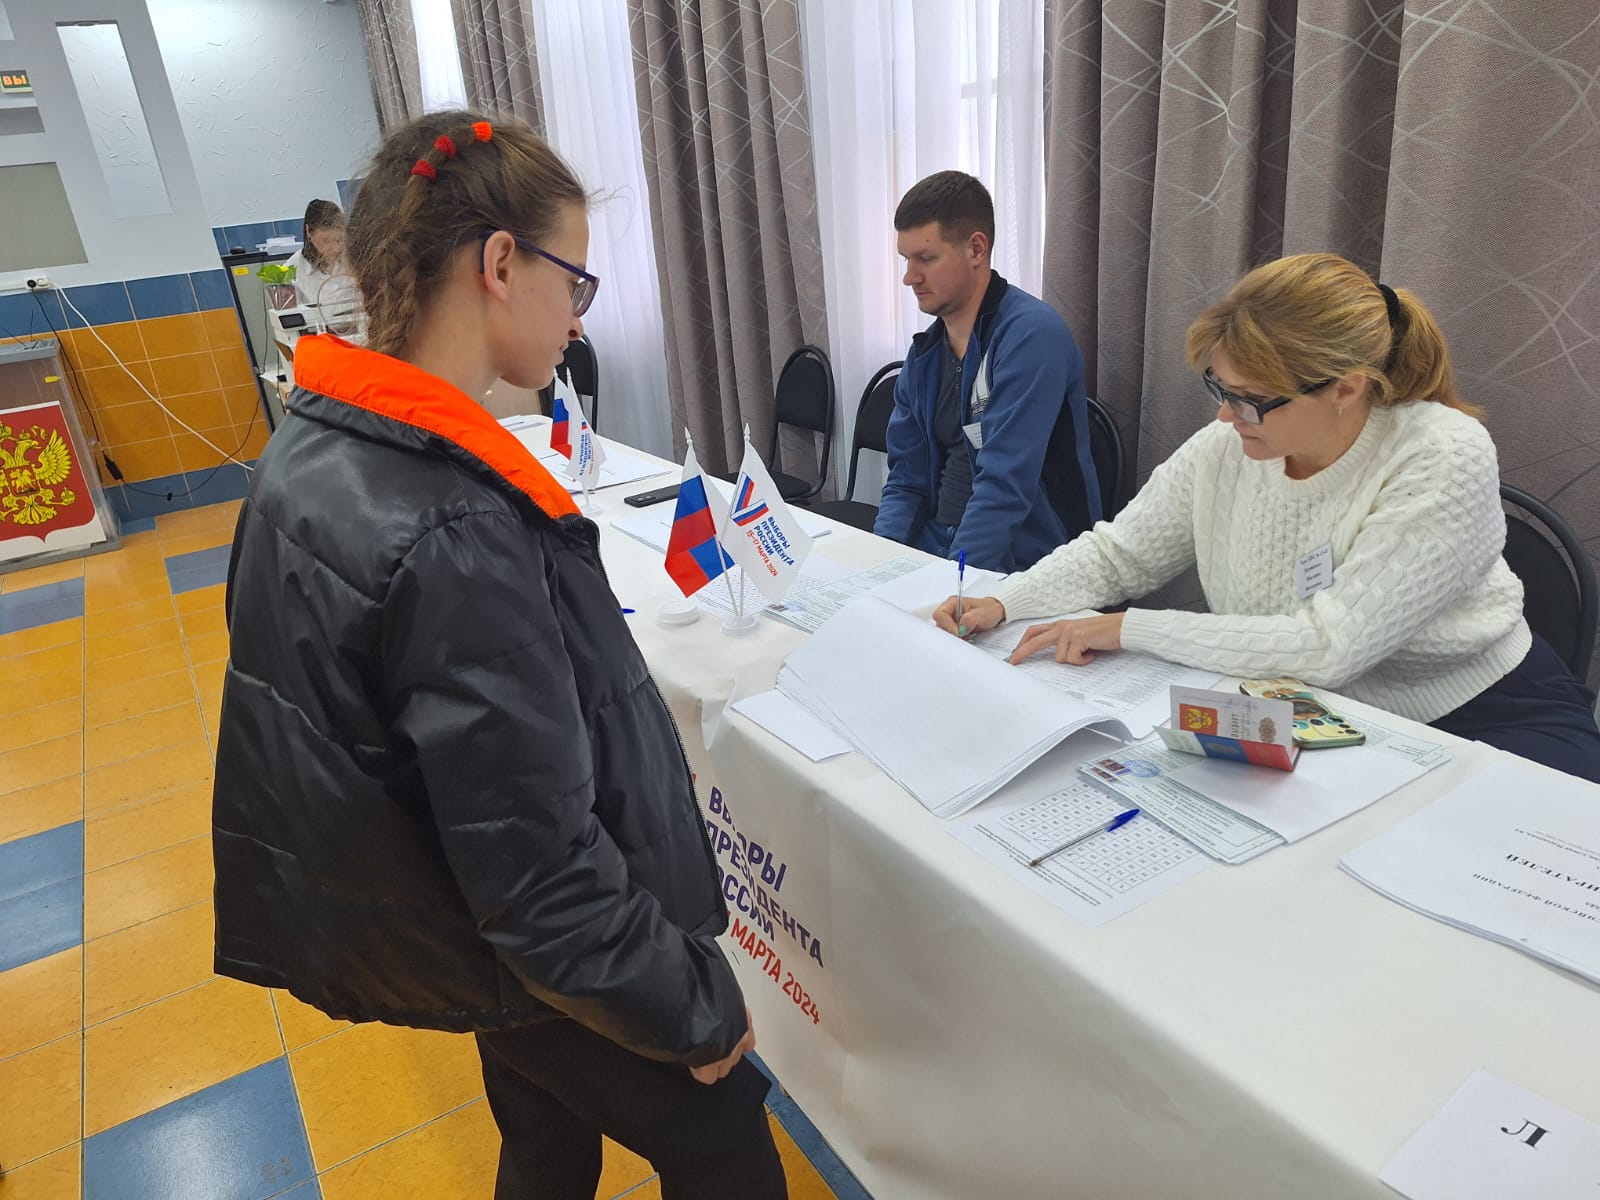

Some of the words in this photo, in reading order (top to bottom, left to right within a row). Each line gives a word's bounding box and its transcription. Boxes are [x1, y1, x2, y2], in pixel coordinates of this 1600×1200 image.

[754, 525, 774, 555] РОССИИ
[761, 521, 795, 566] ПРЕЗИДЕНТА
[768, 516, 791, 549] ВЫБОРЫ
[757, 545, 769, 564] МАРТА
[730, 918, 782, 983] МАРТА
[782, 971, 820, 1025] 2024
[1500, 1117, 1552, 1150] Л
